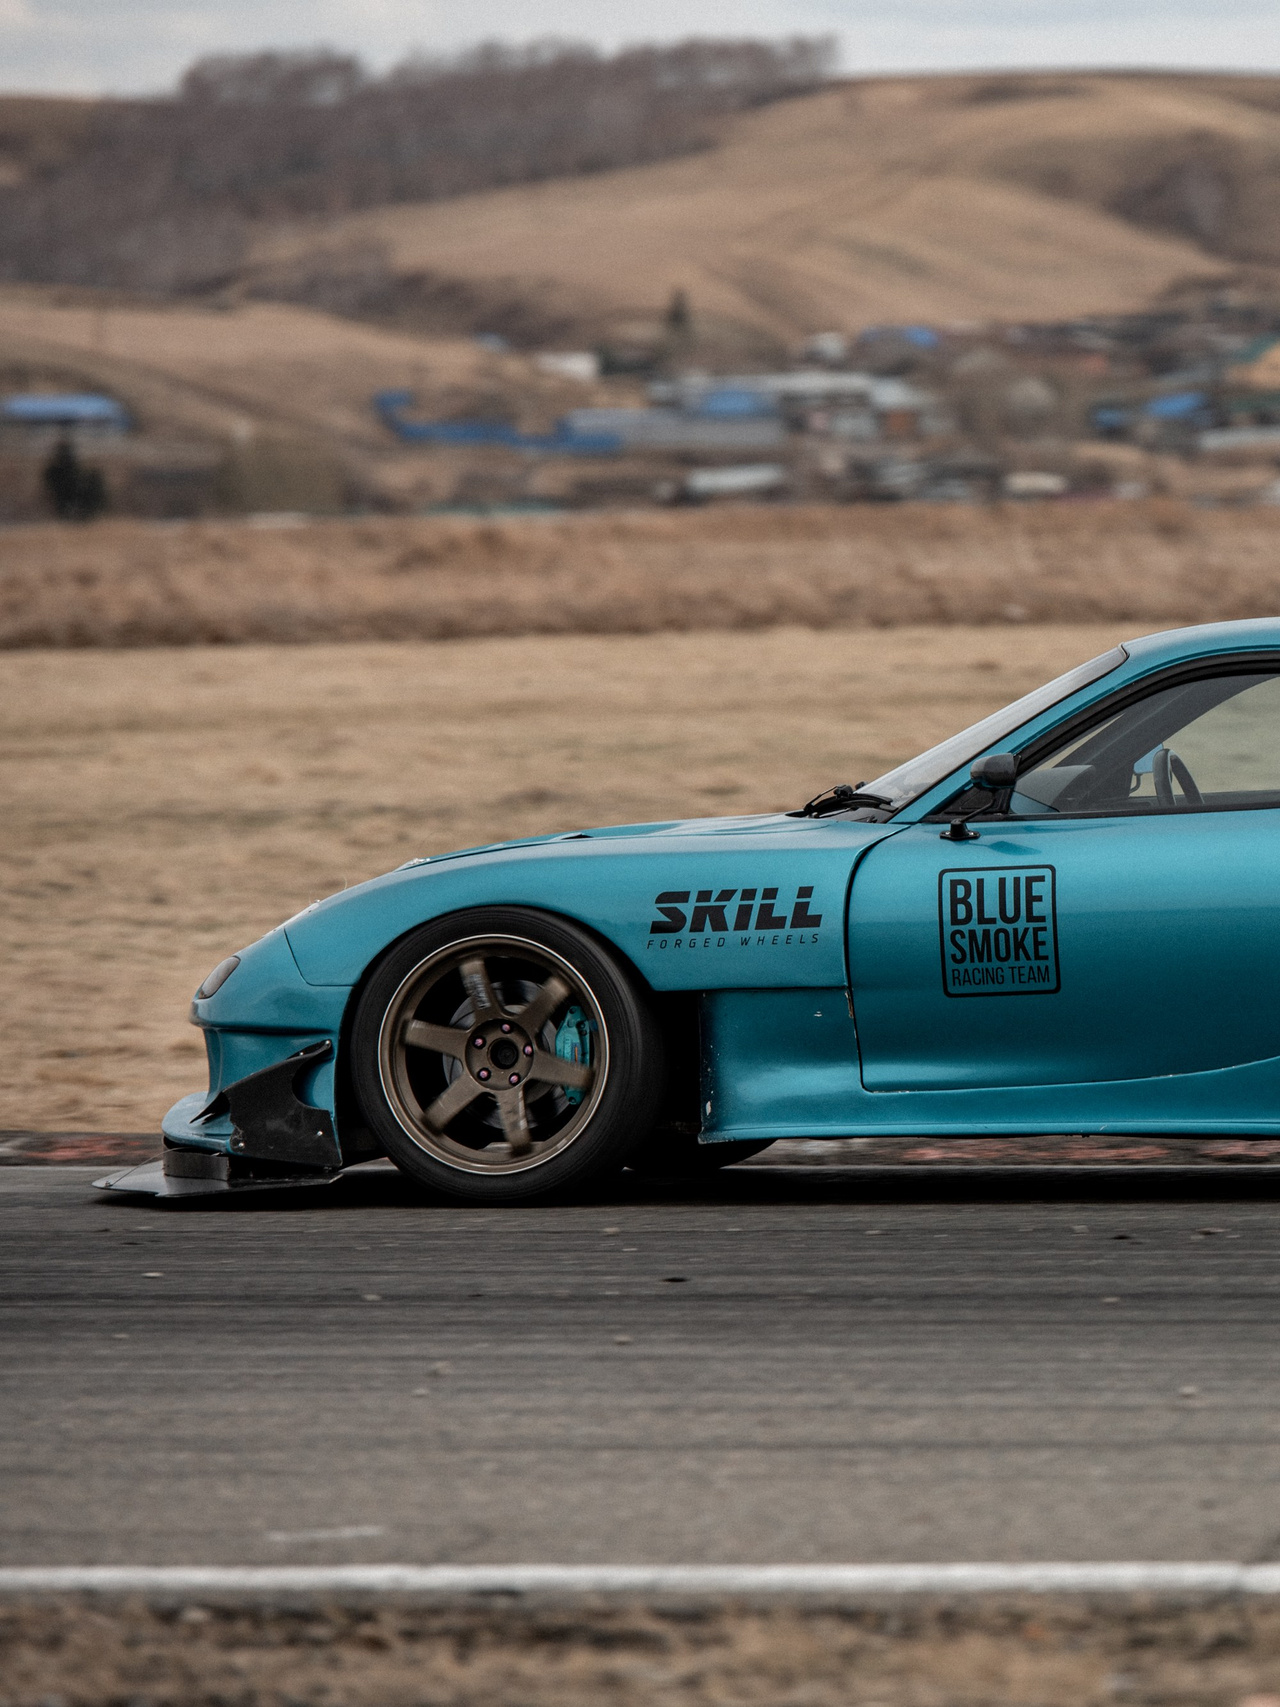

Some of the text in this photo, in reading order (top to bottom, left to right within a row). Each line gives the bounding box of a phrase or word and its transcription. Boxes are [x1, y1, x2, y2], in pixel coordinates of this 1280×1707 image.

[649, 885, 823, 935] SKILL
[949, 875, 1047, 926] BLUE
[646, 933, 820, 950] FORGED WHEELS
[949, 926, 1050, 965] SMOKE
[951, 965, 1051, 987] RACING TEAM
